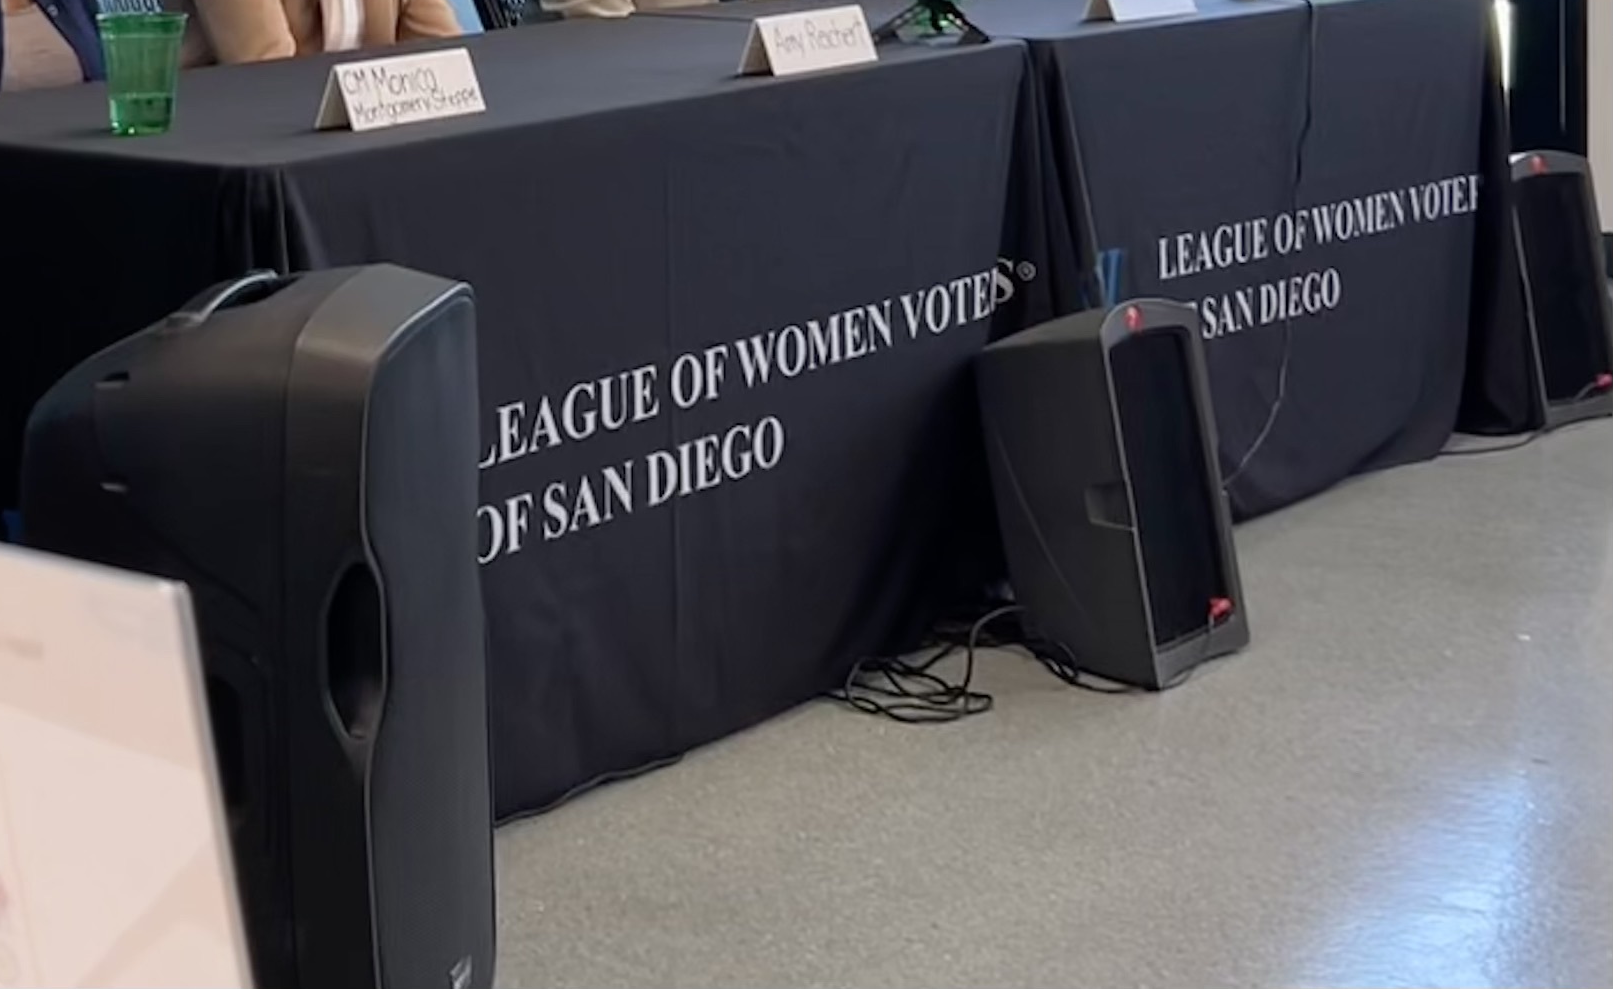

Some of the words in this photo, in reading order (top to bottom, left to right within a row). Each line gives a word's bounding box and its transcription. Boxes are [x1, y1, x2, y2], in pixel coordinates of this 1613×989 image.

[1158, 218, 1268, 280] LEAGUE
[1274, 210, 1308, 256] OF
[1311, 188, 1405, 244] WOMEN
[1202, 286, 1256, 339] SAN
[1260, 267, 1342, 326] DIEGO
[671, 343, 729, 409] OF
[735, 300, 894, 389] WOMEN
[476, 491, 534, 564] OF
[542, 461, 634, 541] SAN
[646, 415, 786, 507] DIEGO
